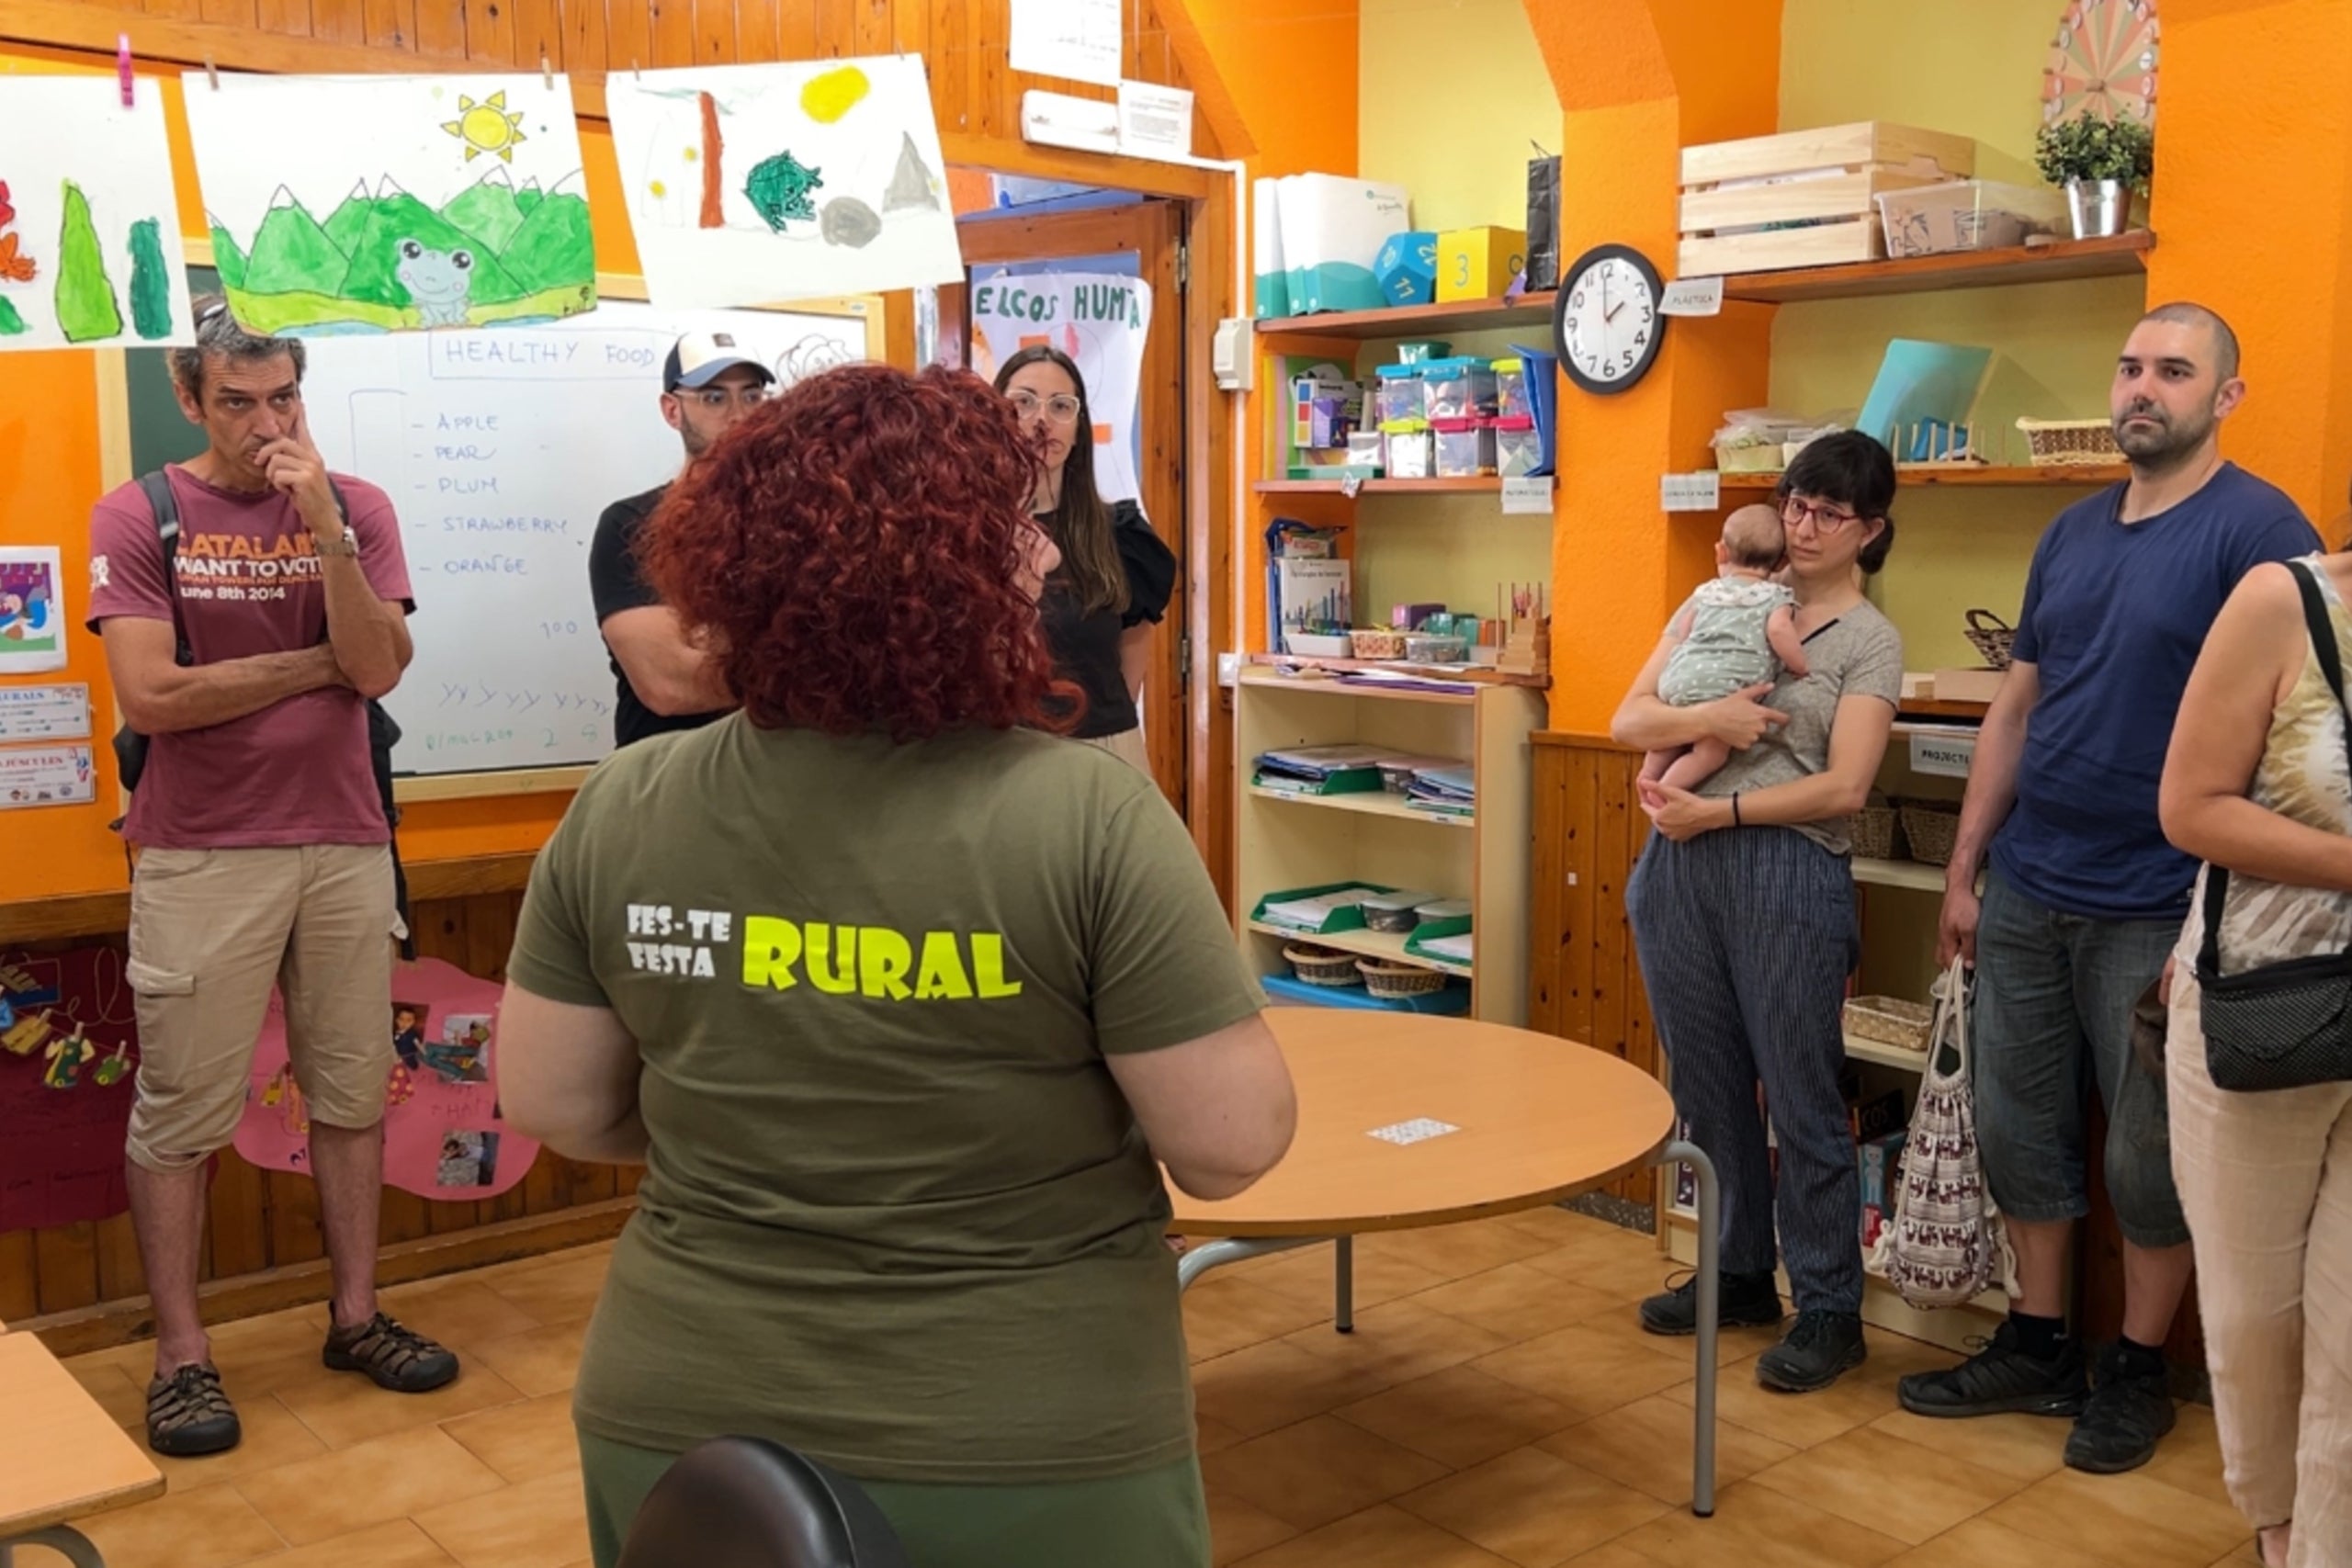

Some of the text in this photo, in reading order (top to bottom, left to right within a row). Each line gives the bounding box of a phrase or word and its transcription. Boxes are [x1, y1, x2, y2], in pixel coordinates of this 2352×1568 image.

[1455, 254, 1468, 288] 3
[1640, 306, 1652, 322] 3
[1566, 317, 1577, 333] 9
[1634, 330, 1645, 346] 4
[447, 340, 656, 366] HEALTHY FOOD
[1623, 350, 1634, 369] 5
[1587, 355, 1598, 373] 7
[1602, 359, 1615, 378] 6
[436, 414, 499, 432] APPLE
[435, 446, 497, 461] PEAR
[437, 478, 498, 494] PLUM
[442, 517, 568, 534] STRAWBERRY
[174, 556, 242, 577] WANT
[245, 560, 277, 578] TO
[444, 555, 528, 576] ORANGE
[217, 585, 244, 600] 8th
[248, 586, 286, 601] 2014
[627, 904, 731, 942] FES-TE
[627, 942, 716, 977] FESTA
[742, 916, 1023, 1001] RURAL
